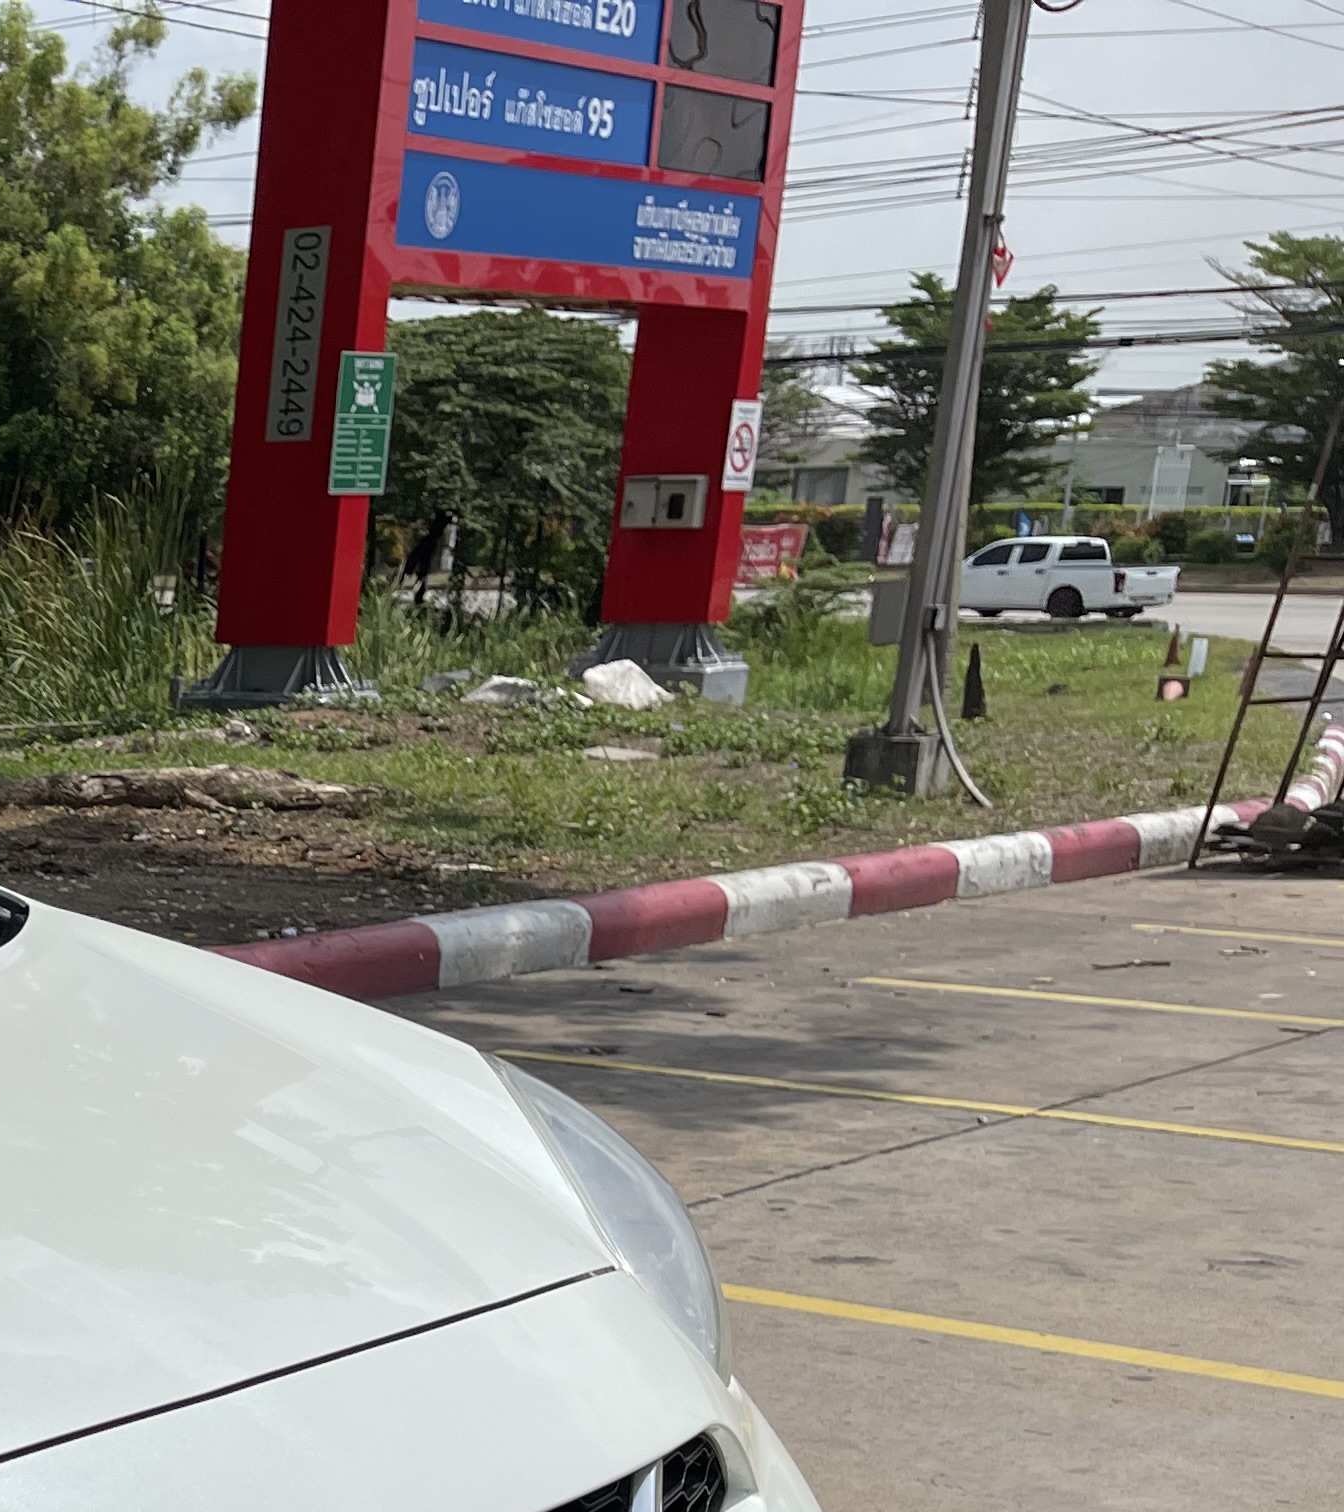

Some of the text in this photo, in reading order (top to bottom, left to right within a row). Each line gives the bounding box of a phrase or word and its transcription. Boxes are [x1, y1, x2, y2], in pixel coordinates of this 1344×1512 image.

[594, 0, 637, 37] E20
[587, 97, 616, 139] 95
[276, 231, 323, 437] 02-424-2449
